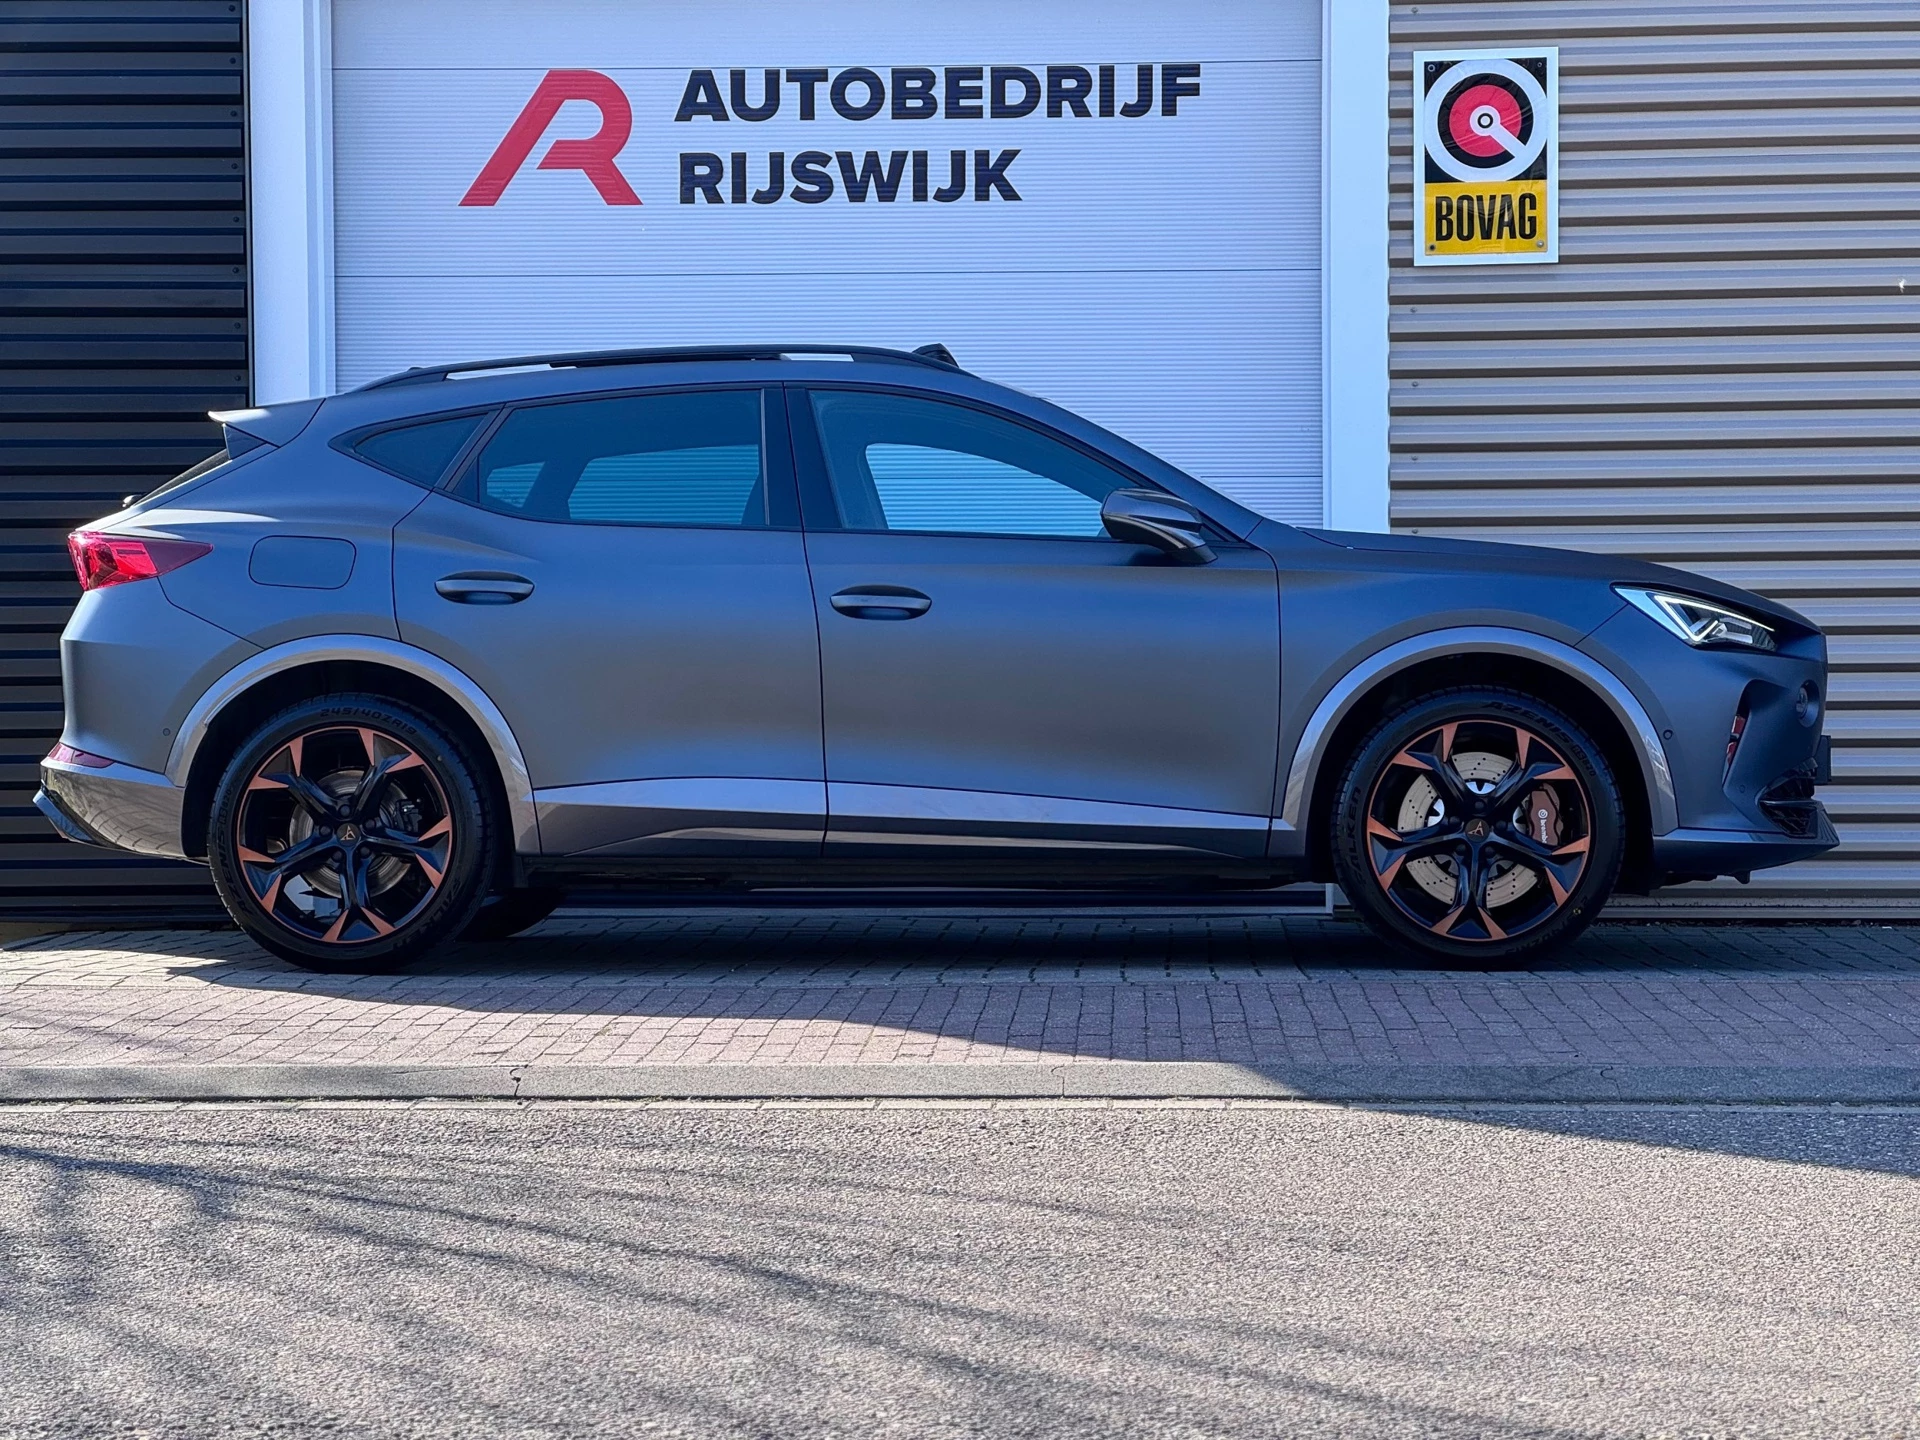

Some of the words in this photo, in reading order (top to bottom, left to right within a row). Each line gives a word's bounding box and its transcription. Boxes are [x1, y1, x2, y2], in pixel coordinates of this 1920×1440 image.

[674, 63, 1201, 122] AUTOBEDRIJF
[678, 148, 1023, 205] RIJSWIJK
[1435, 193, 1537, 241] BOVAG
[320, 707, 417, 735] 245/40ZR19
[1482, 700, 1573, 746] AZENIS
